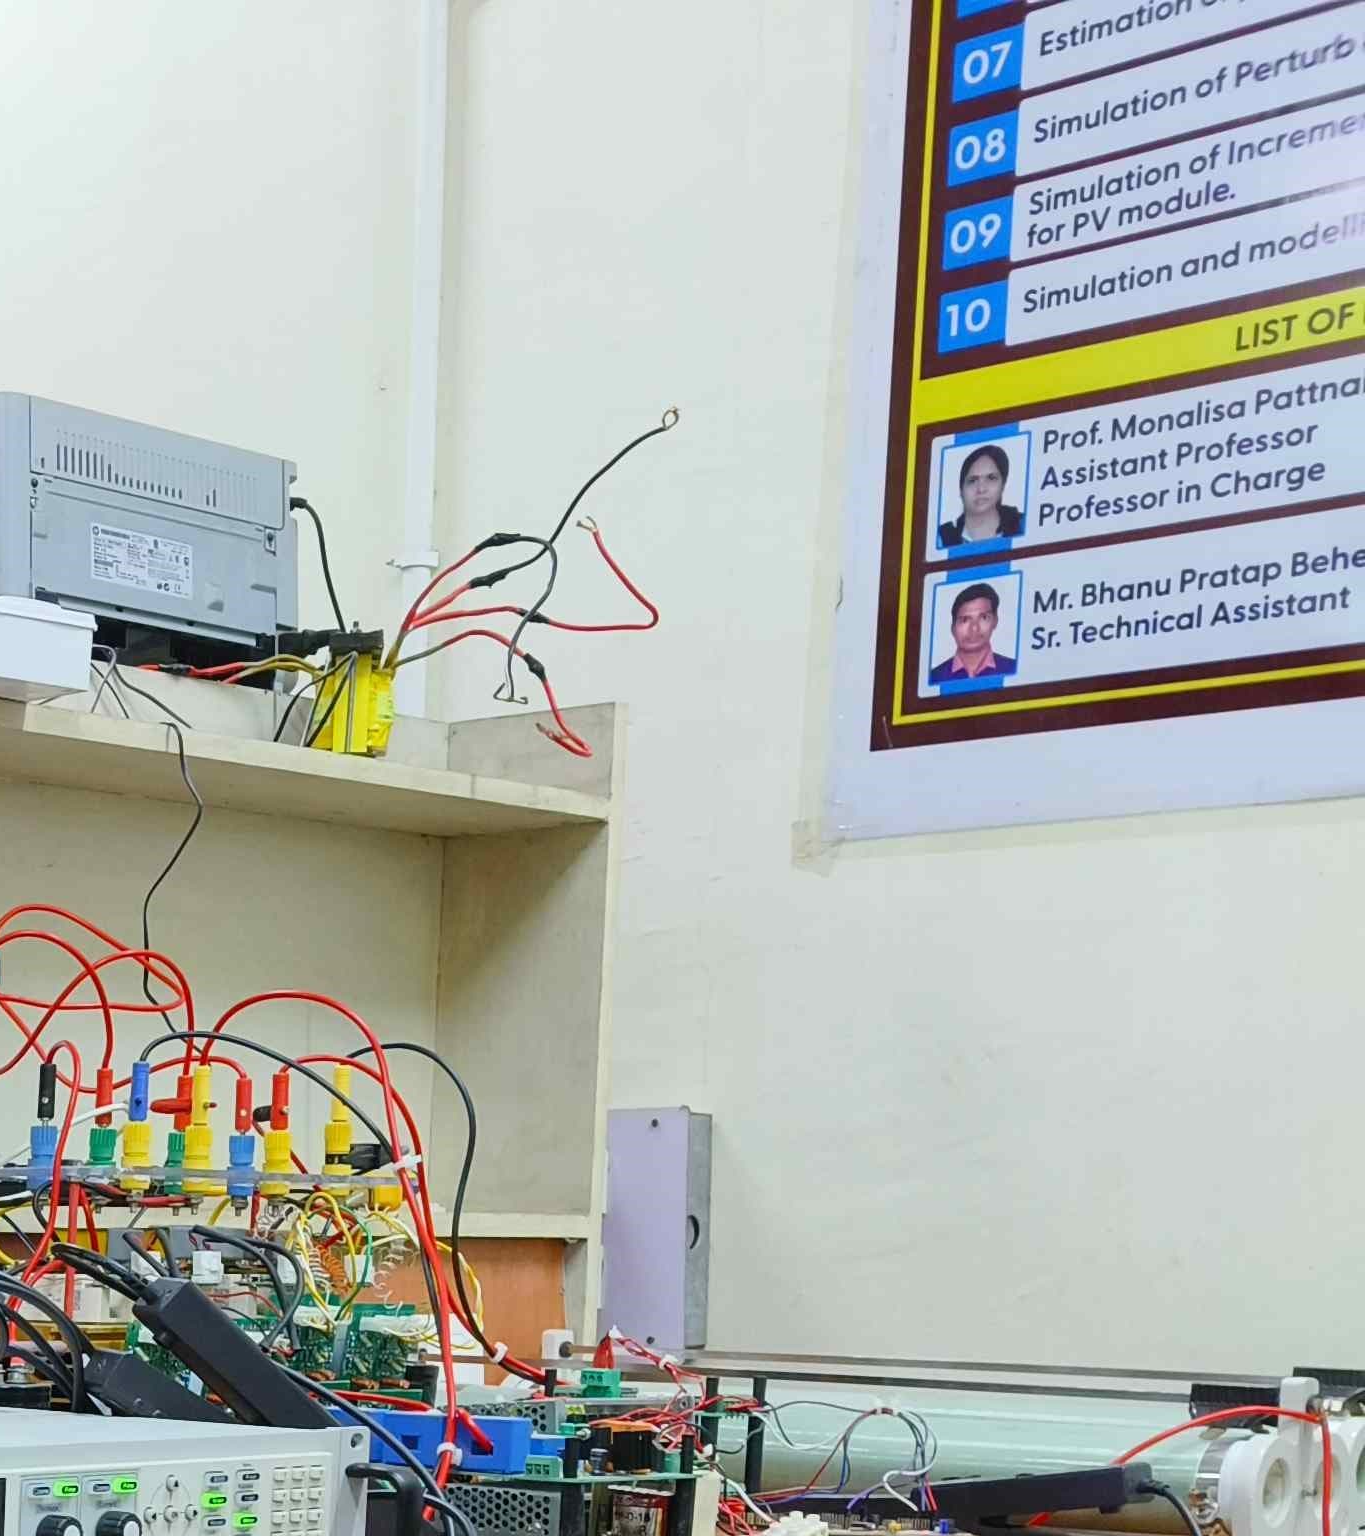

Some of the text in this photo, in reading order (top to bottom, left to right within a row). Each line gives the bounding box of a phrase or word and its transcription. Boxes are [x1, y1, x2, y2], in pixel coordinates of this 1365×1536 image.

[962, 0, 1191, 84] 07 Estimation
[955, 34, 1355, 170] 08 Simulation of Perturb
[950, 213, 1002, 253] 09
[1028, 160, 1181, 216] Simulation
[1189, 144, 1221, 174] of
[1027, 180, 1236, 249] for PV module.
[946, 298, 991, 336] 10
[1023, 263, 1172, 314] Simulation
[1181, 240, 1241, 278] and
[1236, 314, 1298, 352] LIST
[1307, 301, 1356, 335] OF
[1040, 423, 1318, 490] Assistant Professor
[1042, 421, 1105, 454] Prof.
[1111, 399, 1246, 440] Monalisa
[1038, 461, 1326, 527] Professor in Charge
[1031, 585, 1351, 651] Sr. Technical Assistant
[1033, 587, 1074, 614] Mr.
[1080, 573, 1172, 608] Bhanu
[1180, 560, 1282, 593] Pratap
